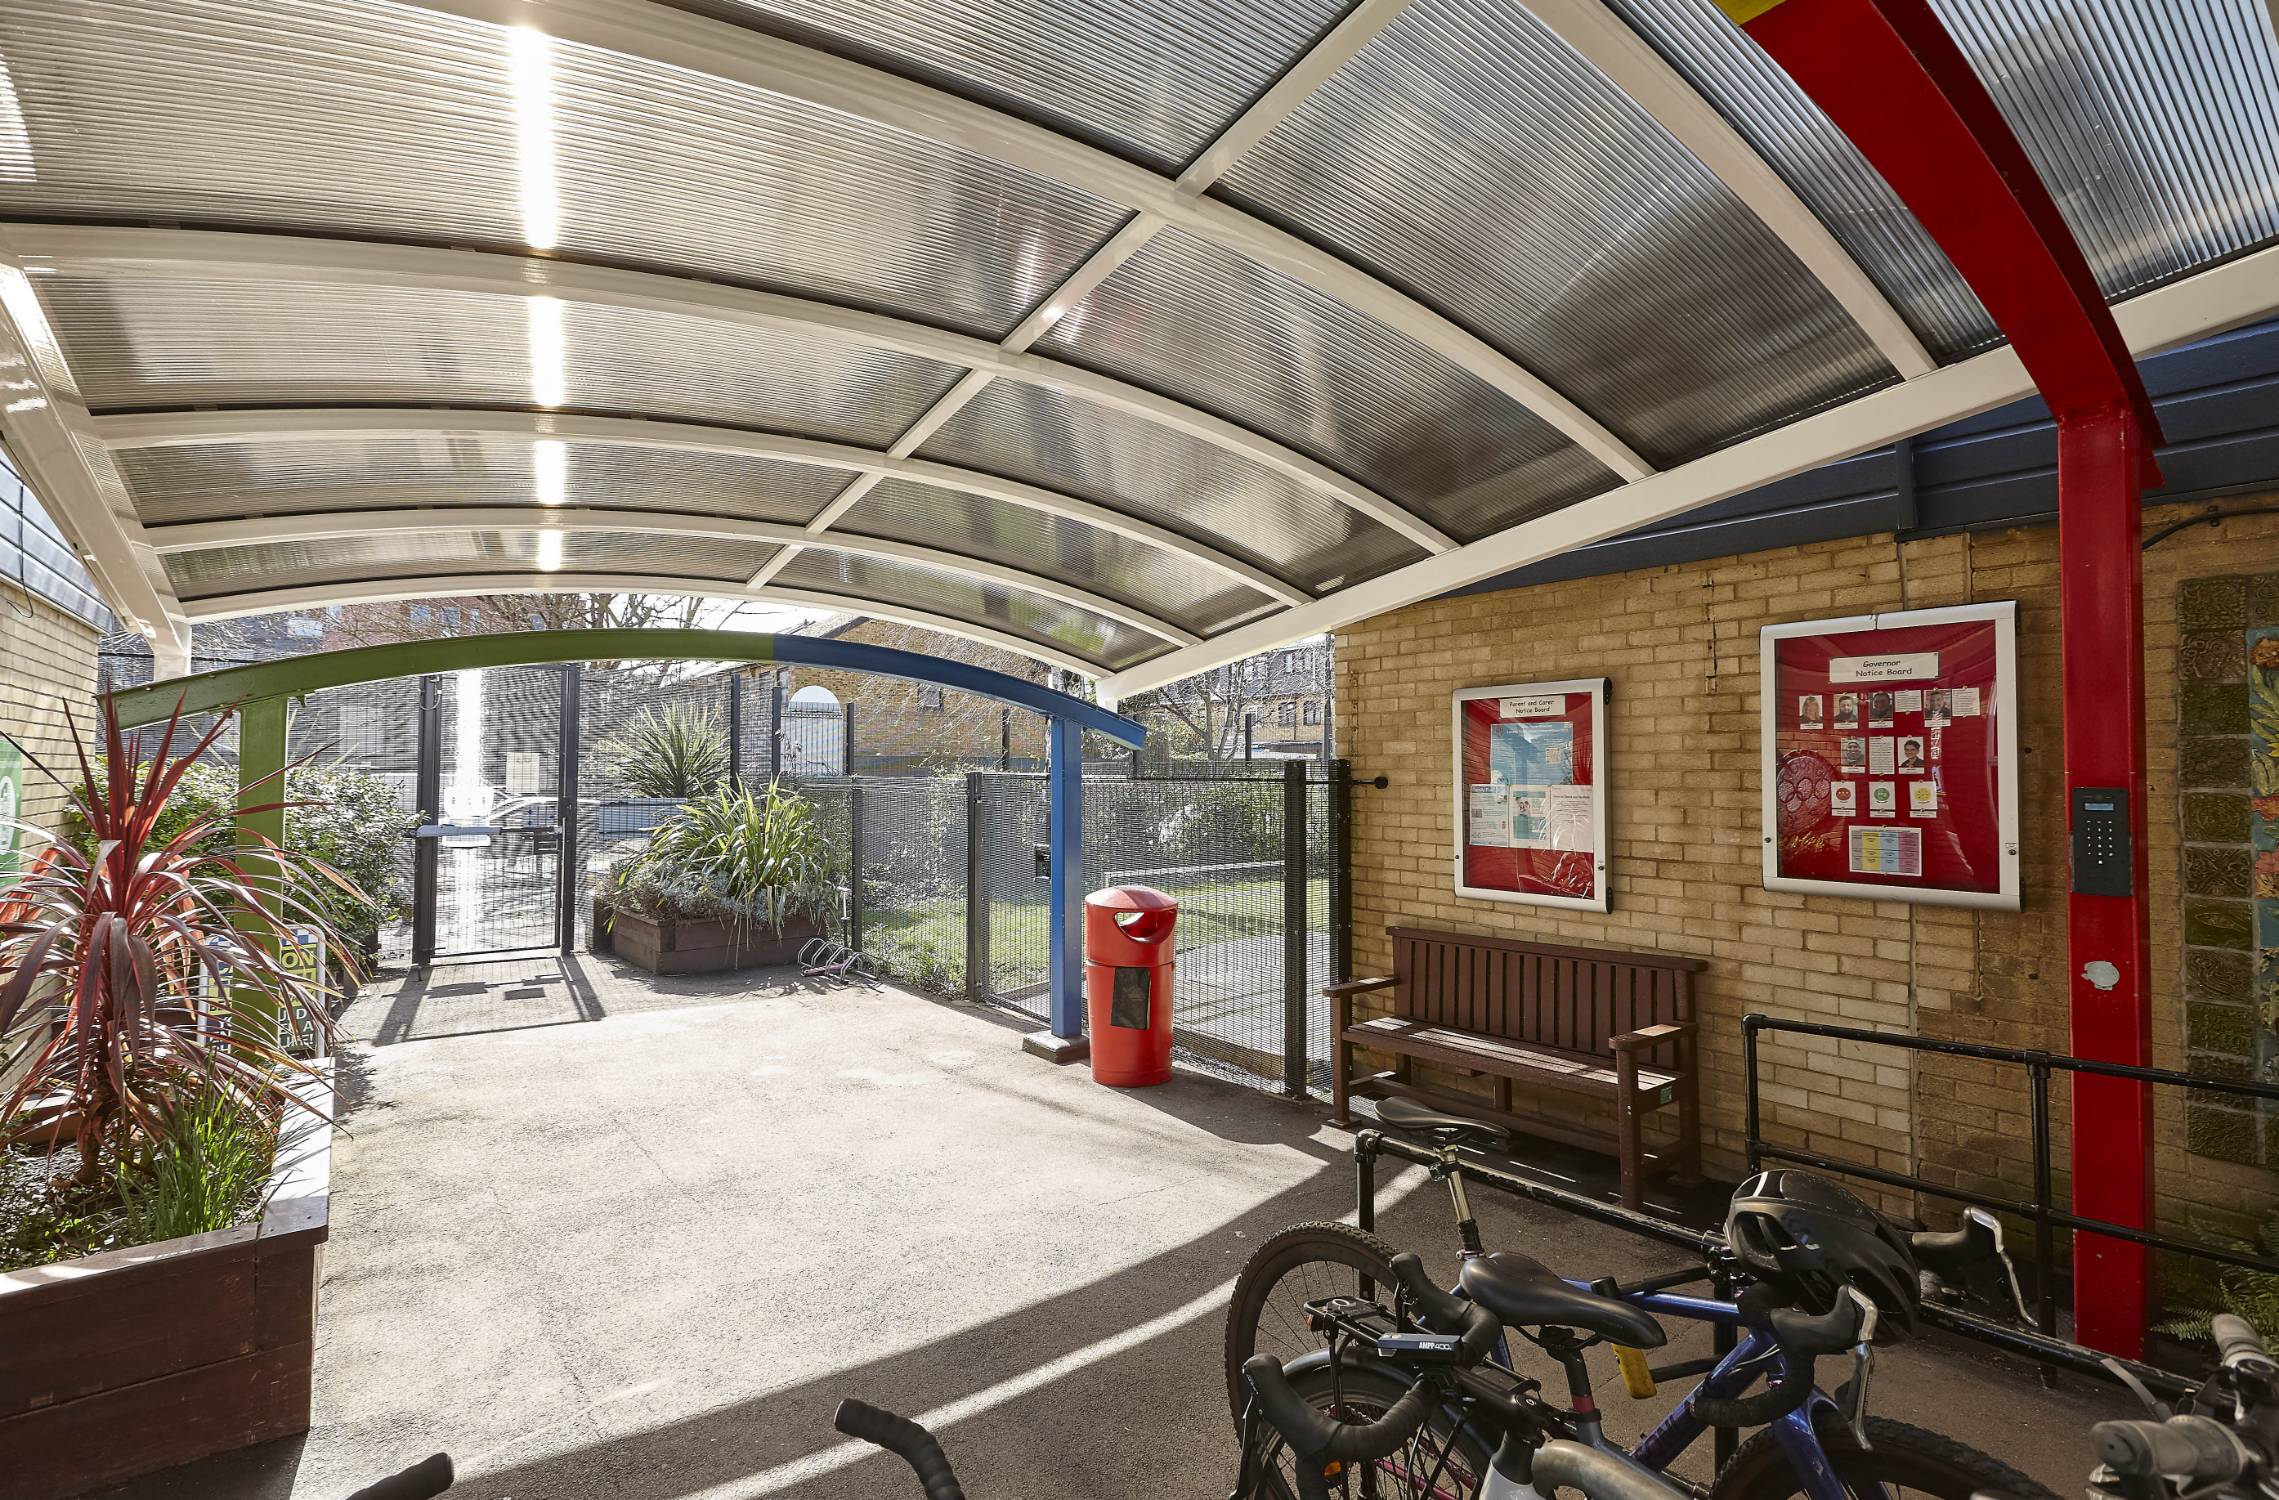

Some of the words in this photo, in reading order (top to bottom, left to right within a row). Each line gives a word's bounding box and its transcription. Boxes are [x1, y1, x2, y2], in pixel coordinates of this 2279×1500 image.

[1862, 660, 1901, 668] Governor
[1855, 669, 1883, 677] Notice
[1886, 667, 1913, 676] Board
